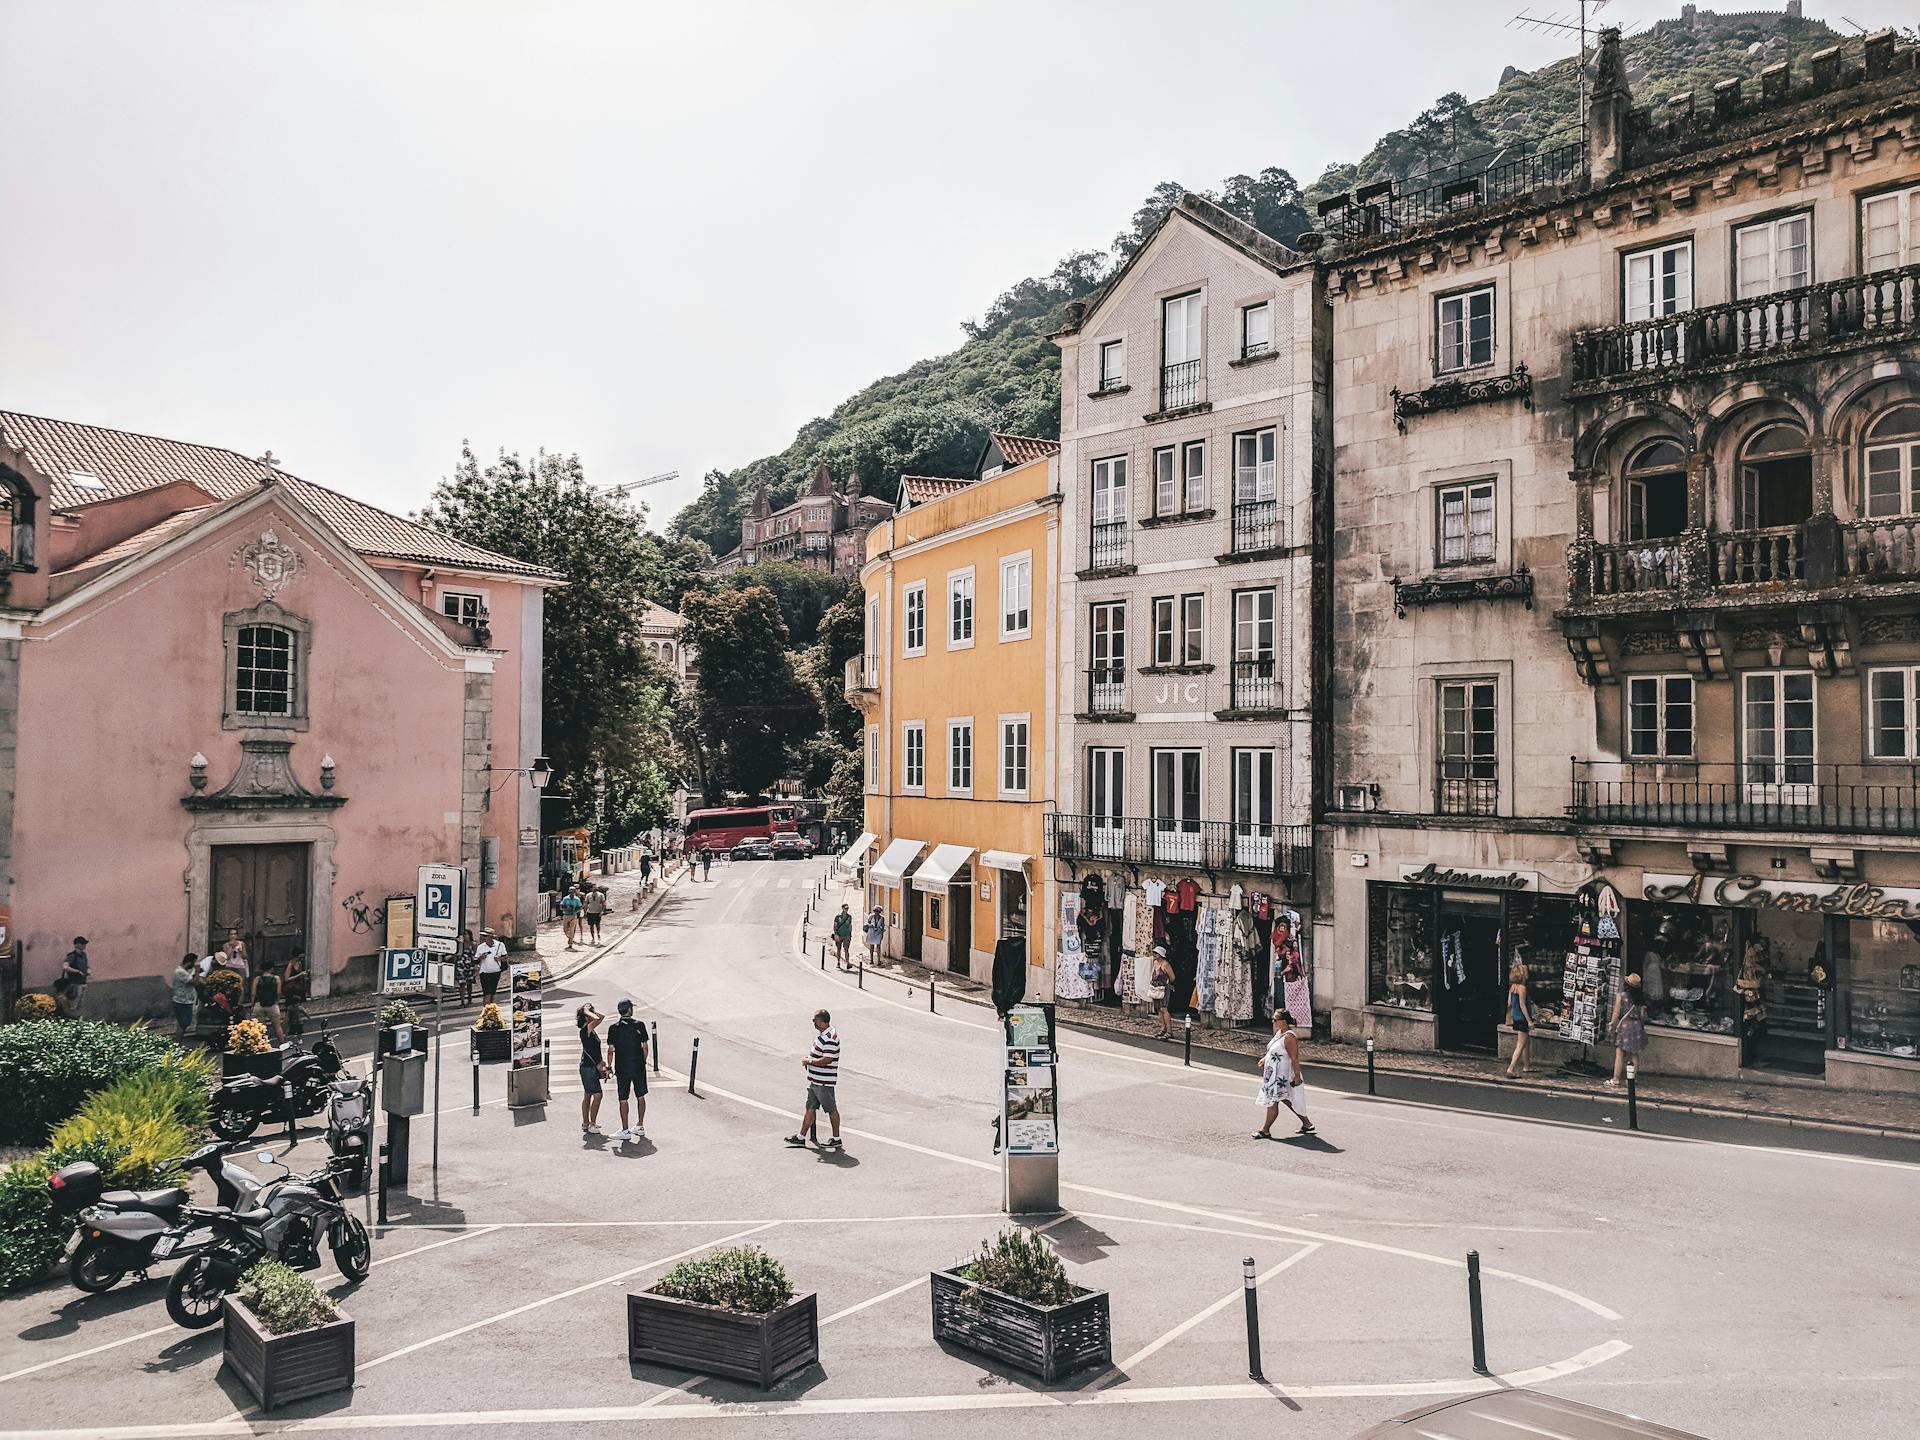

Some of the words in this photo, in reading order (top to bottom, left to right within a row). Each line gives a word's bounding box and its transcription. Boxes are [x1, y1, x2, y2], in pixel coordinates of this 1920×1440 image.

[1155, 682, 1200, 704] JIC
[1775, 860, 1782, 868] 8
[1403, 863, 1529, 889] Artesanato
[427, 886, 442, 910] P
[1643, 872, 1704, 905] A
[1169, 898, 1176, 911] 7
[392, 953, 411, 978] P
[398, 1031, 410, 1047] P
